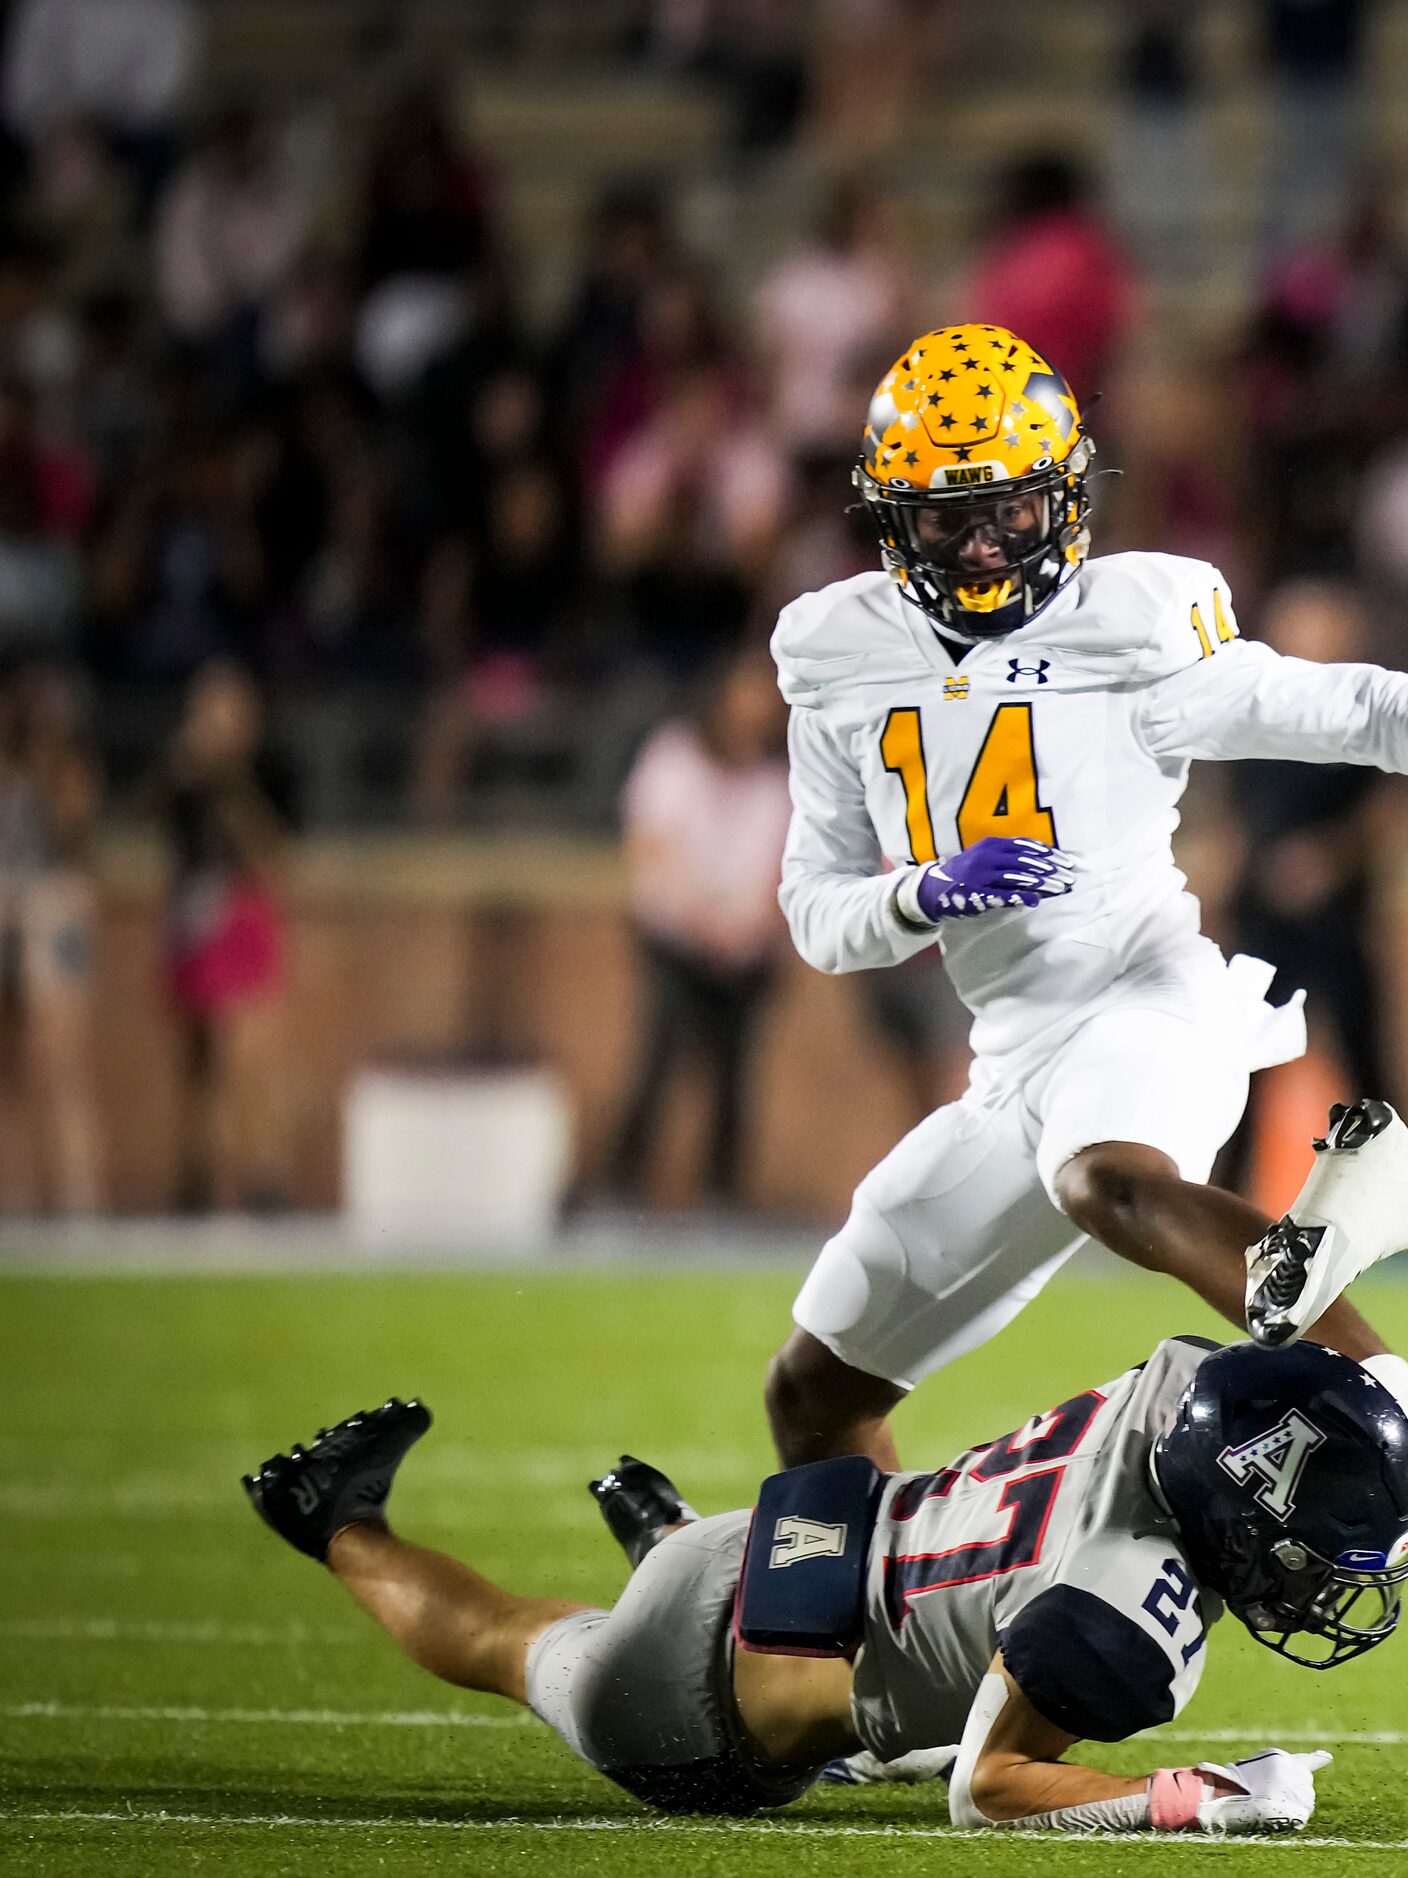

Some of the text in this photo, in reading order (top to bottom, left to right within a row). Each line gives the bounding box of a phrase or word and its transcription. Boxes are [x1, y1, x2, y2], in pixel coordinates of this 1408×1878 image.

[1191, 587, 1237, 660] 14
[880, 702, 1060, 866] 14
[883, 1389, 1108, 1631] 21
[1216, 1408, 1327, 1522] A
[768, 1515, 848, 1570] A
